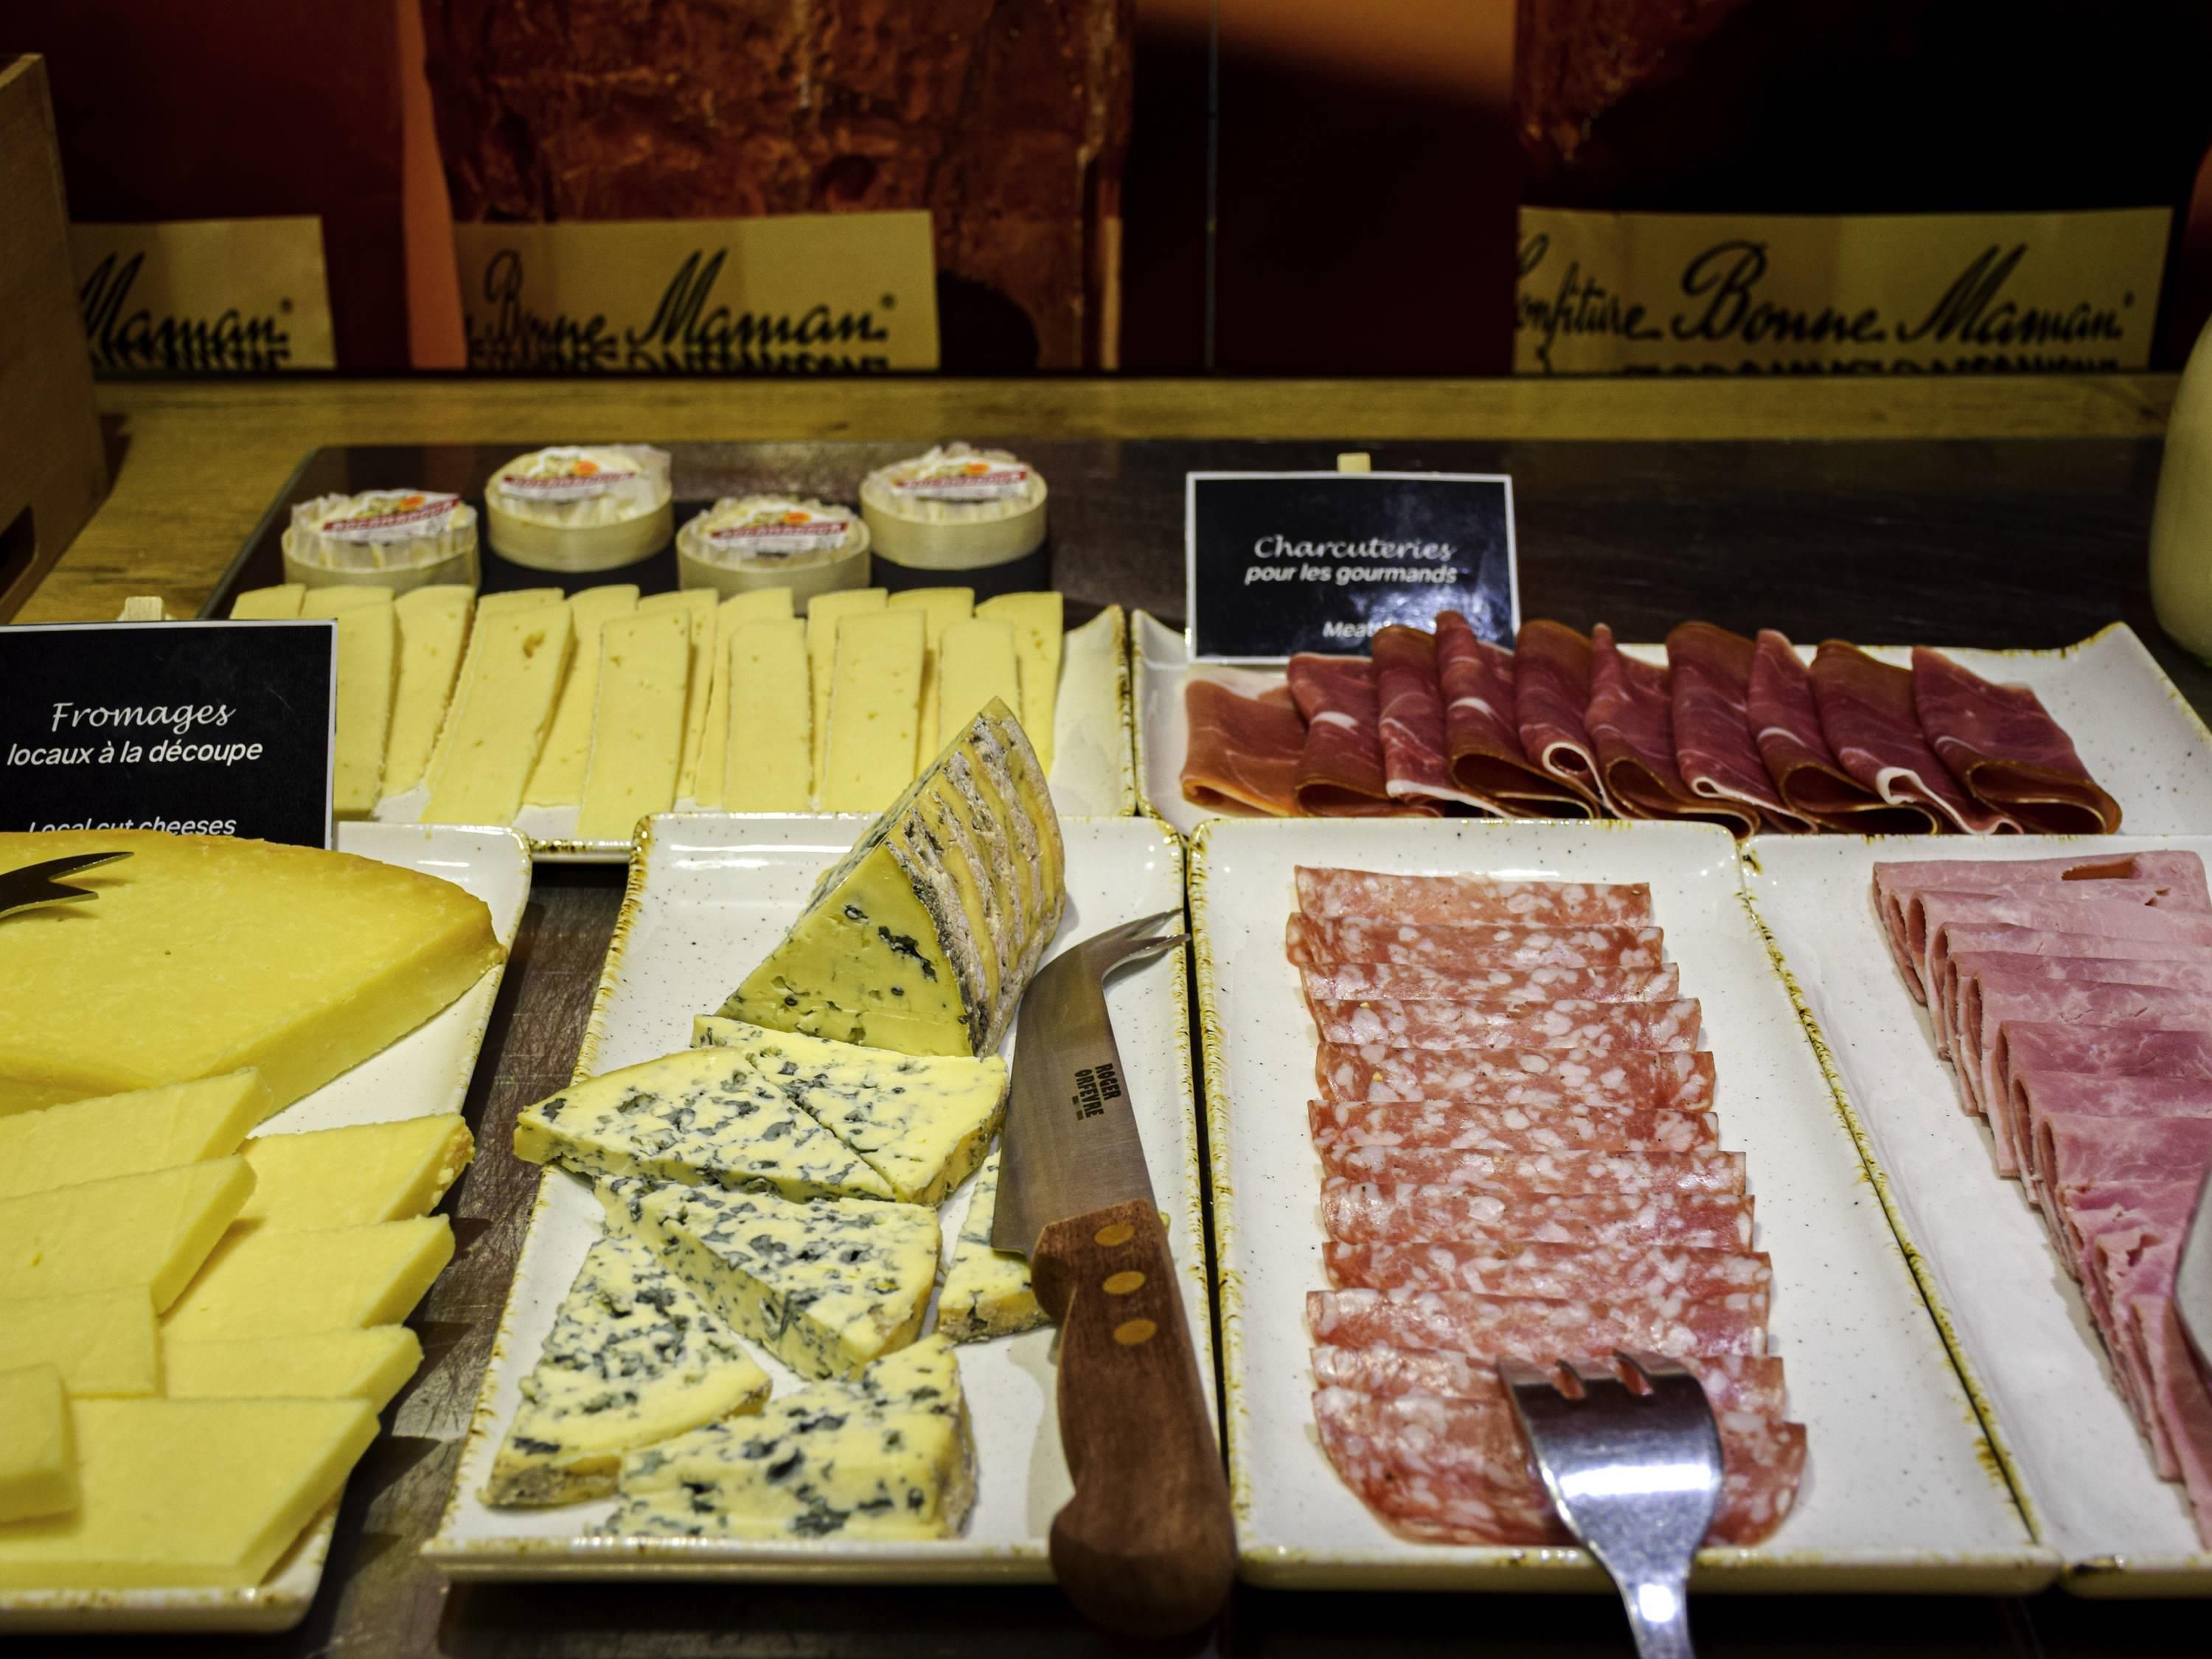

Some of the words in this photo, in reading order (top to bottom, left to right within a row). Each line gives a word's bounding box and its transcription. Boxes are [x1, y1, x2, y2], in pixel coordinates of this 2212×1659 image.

[80, 251, 291, 352] Maman
[625, 248, 889, 346] Maman
[1669, 240, 1888, 343] Bonne
[1896, 243, 2124, 344] Maman
[1254, 534, 1457, 562] Charcuteries
[1244, 565, 1295, 586] pour
[1299, 563, 1332, 581] les
[1335, 564, 1458, 585] gourmands
[52, 700, 237, 735] Fromages
[7, 743, 94, 766] locaux
[98, 740, 114, 765] à
[119, 740, 142, 764] la
[148, 738, 263, 766] découpe
[139, 815, 237, 836] cheeses
[1074, 1068, 1105, 1119] ORFEVRE
[1095, 1062, 1121, 1101] ROGER
